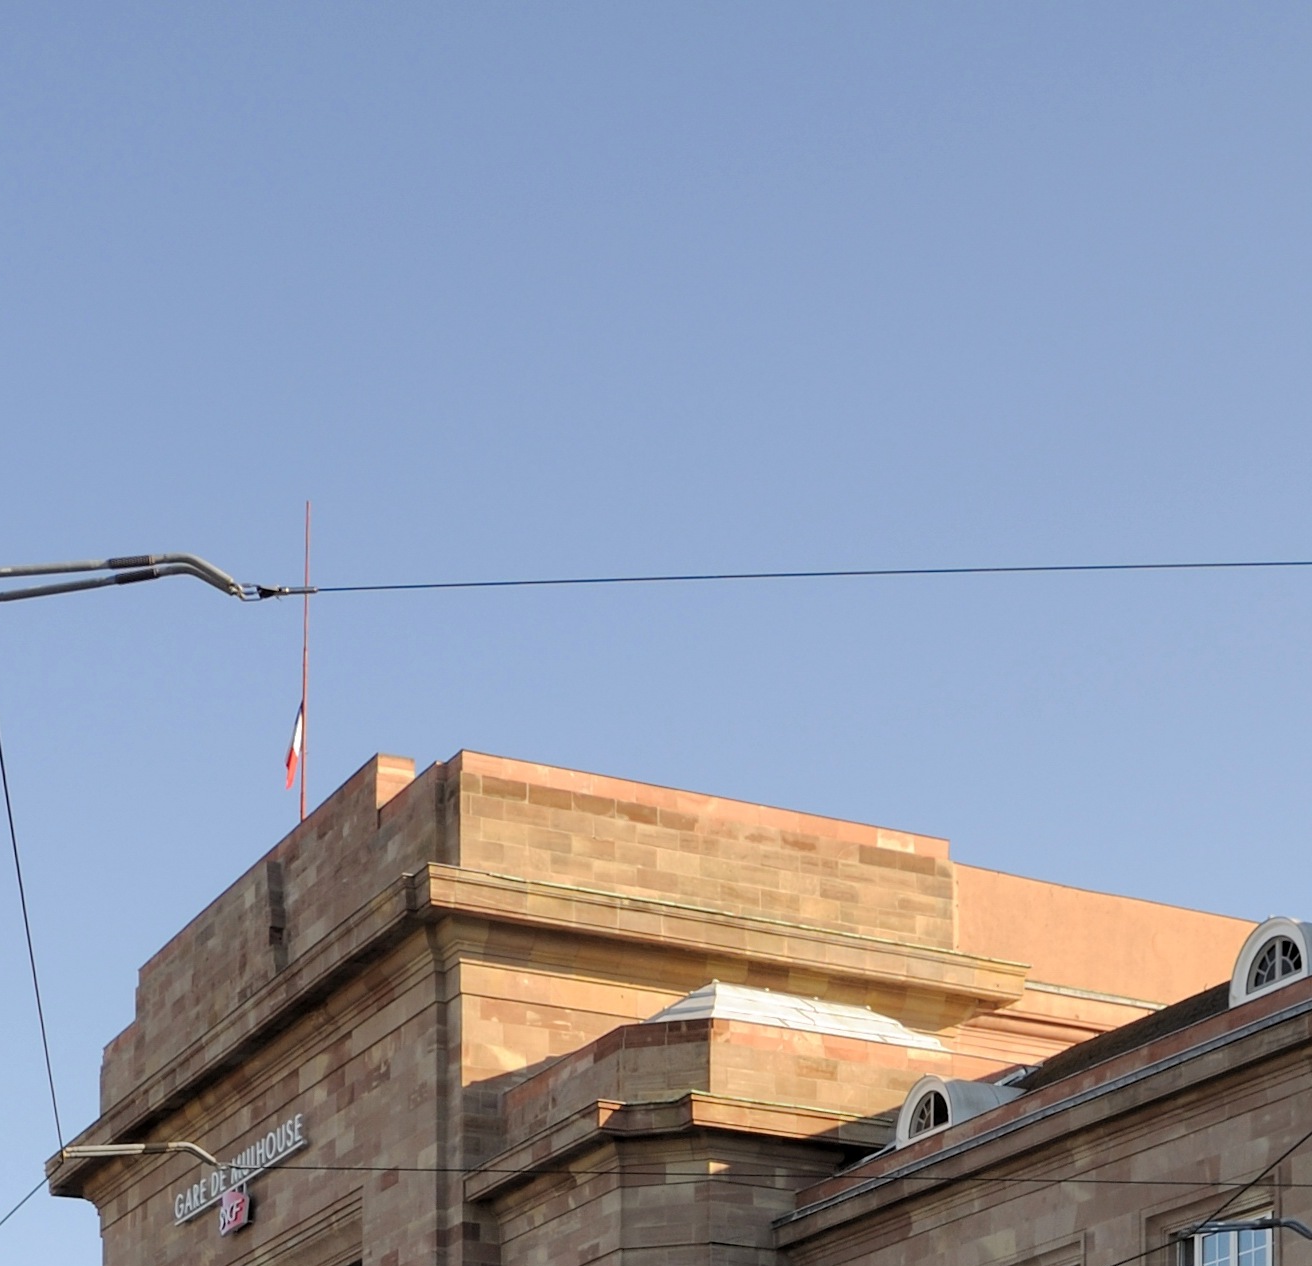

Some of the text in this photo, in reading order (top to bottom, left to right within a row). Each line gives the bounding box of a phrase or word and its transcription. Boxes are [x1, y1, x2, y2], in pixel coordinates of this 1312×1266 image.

[174, 1113, 304, 1219] GARE DE MULHOUSE
[219, 1198, 244, 1231] SNCF
